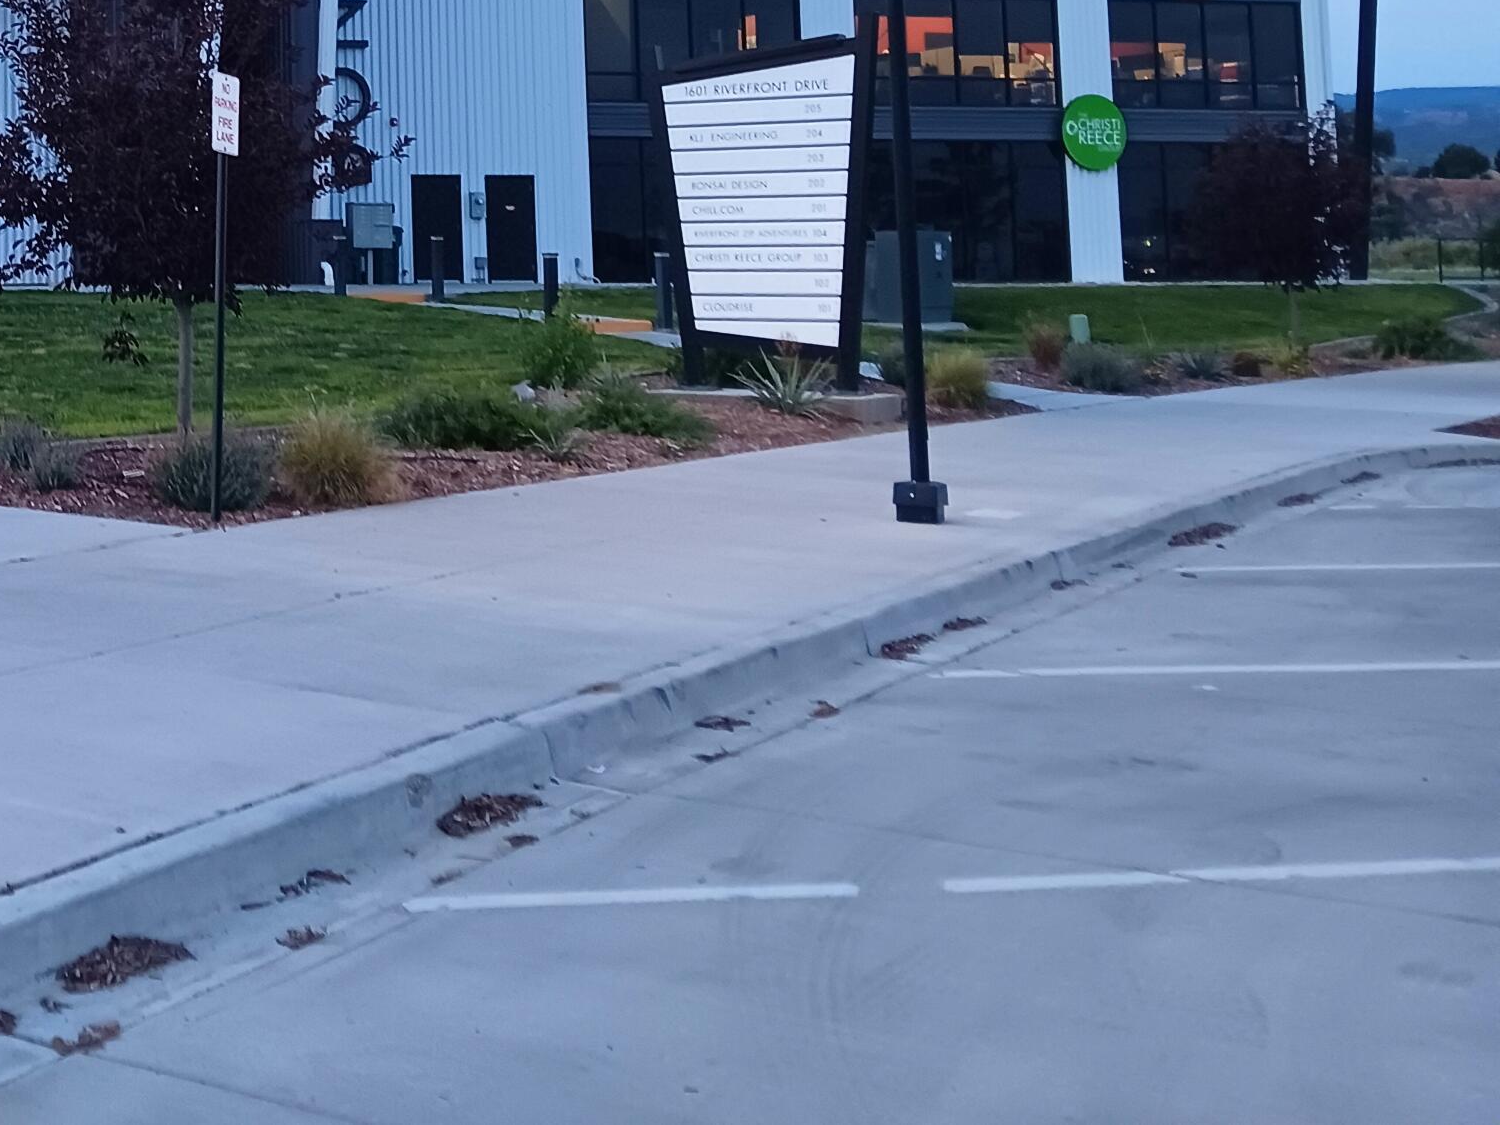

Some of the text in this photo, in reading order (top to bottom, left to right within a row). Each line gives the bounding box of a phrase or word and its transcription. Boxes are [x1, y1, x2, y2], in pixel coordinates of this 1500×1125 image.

[222, 83, 231, 95] NO
[684, 79, 829, 97] 1601 RIVERFRONT DRIVE
[214, 96, 238, 113] PARKING
[804, 103, 822, 114] 205
[218, 116, 233, 130] FIRE
[1078, 118, 1121, 131] CHRISTI
[216, 131, 234, 145] LANE
[689, 128, 823, 143] KLJ ENGINEERING 204
[1078, 130, 1121, 145] REECE
[691, 181, 727, 191] BONSAI
[731, 179, 768, 190] DESIGN
[811, 203, 827, 213] 201
[812, 228, 827, 238] 104
[694, 253, 730, 263] CHRISTI
[734, 253, 762, 263] REECE
[767, 253, 802, 263] GROUP
